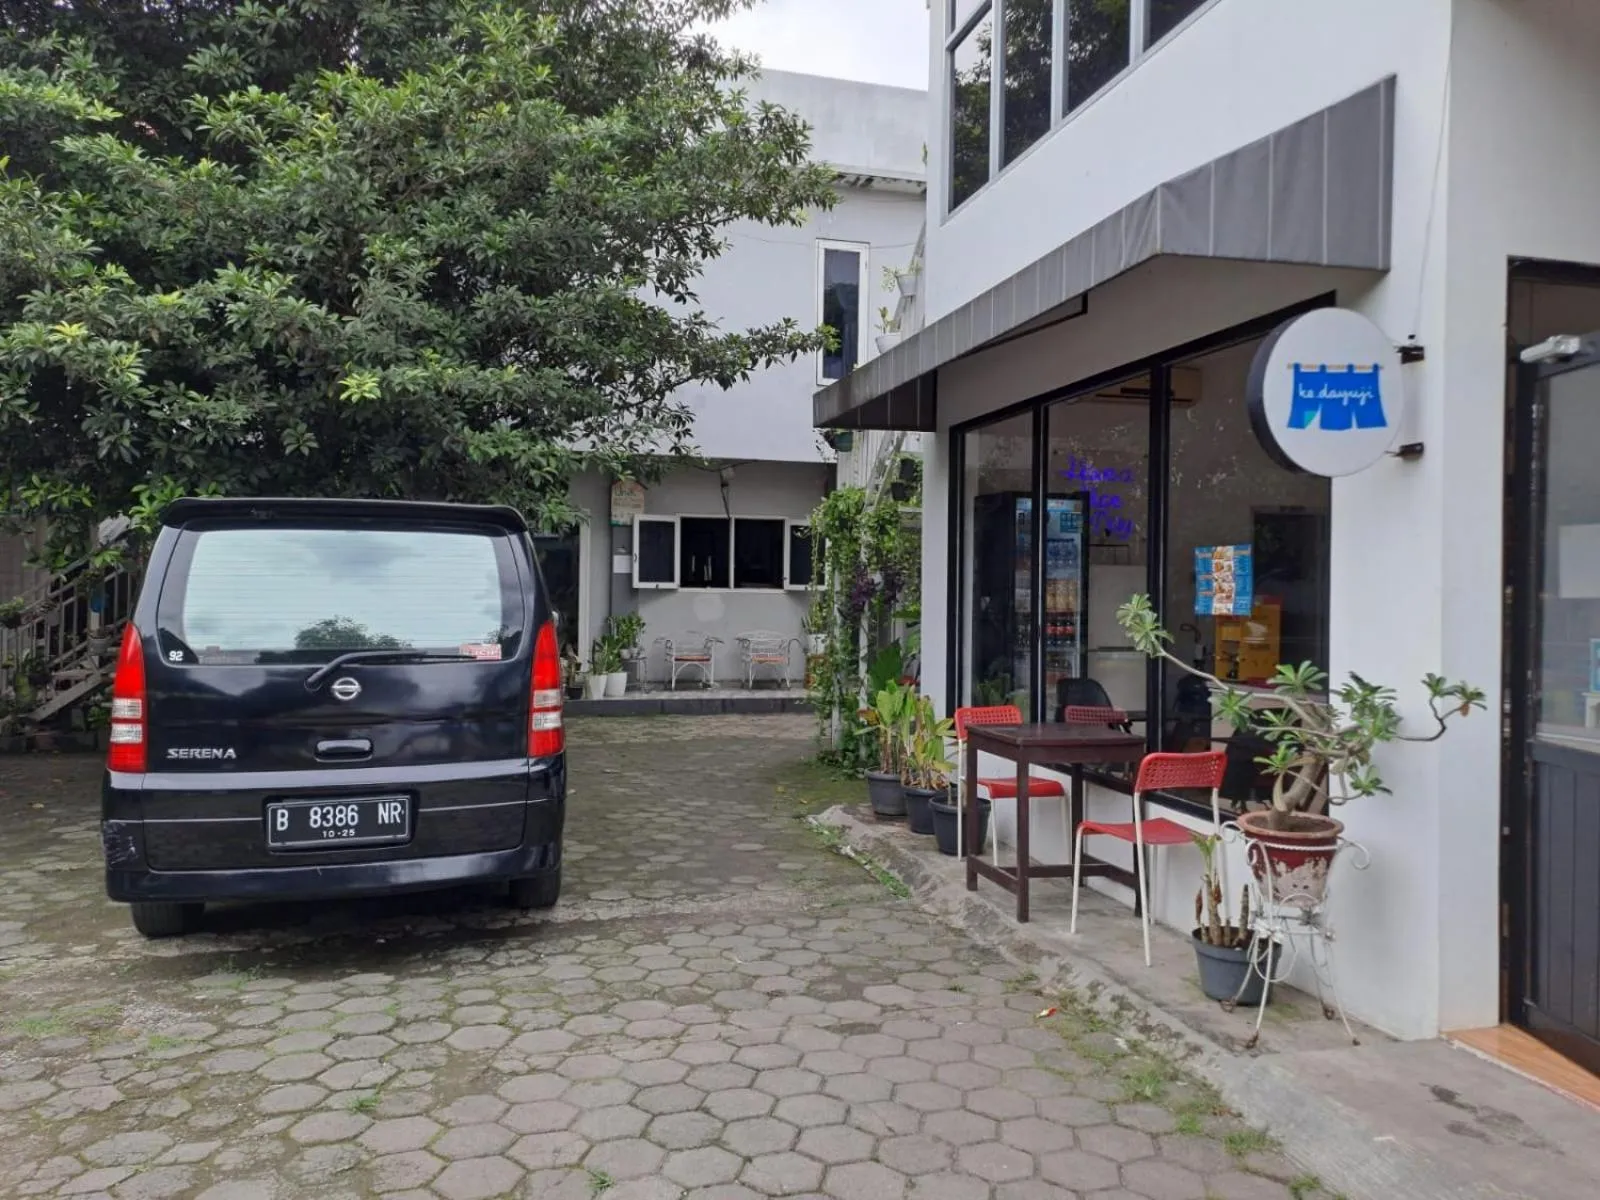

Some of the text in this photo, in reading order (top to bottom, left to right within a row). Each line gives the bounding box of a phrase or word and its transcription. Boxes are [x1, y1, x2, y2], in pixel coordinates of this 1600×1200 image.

[169, 650, 184, 662] 92
[166, 748, 237, 759] SERENA
[276, 802, 402, 831] B 8386 NR
